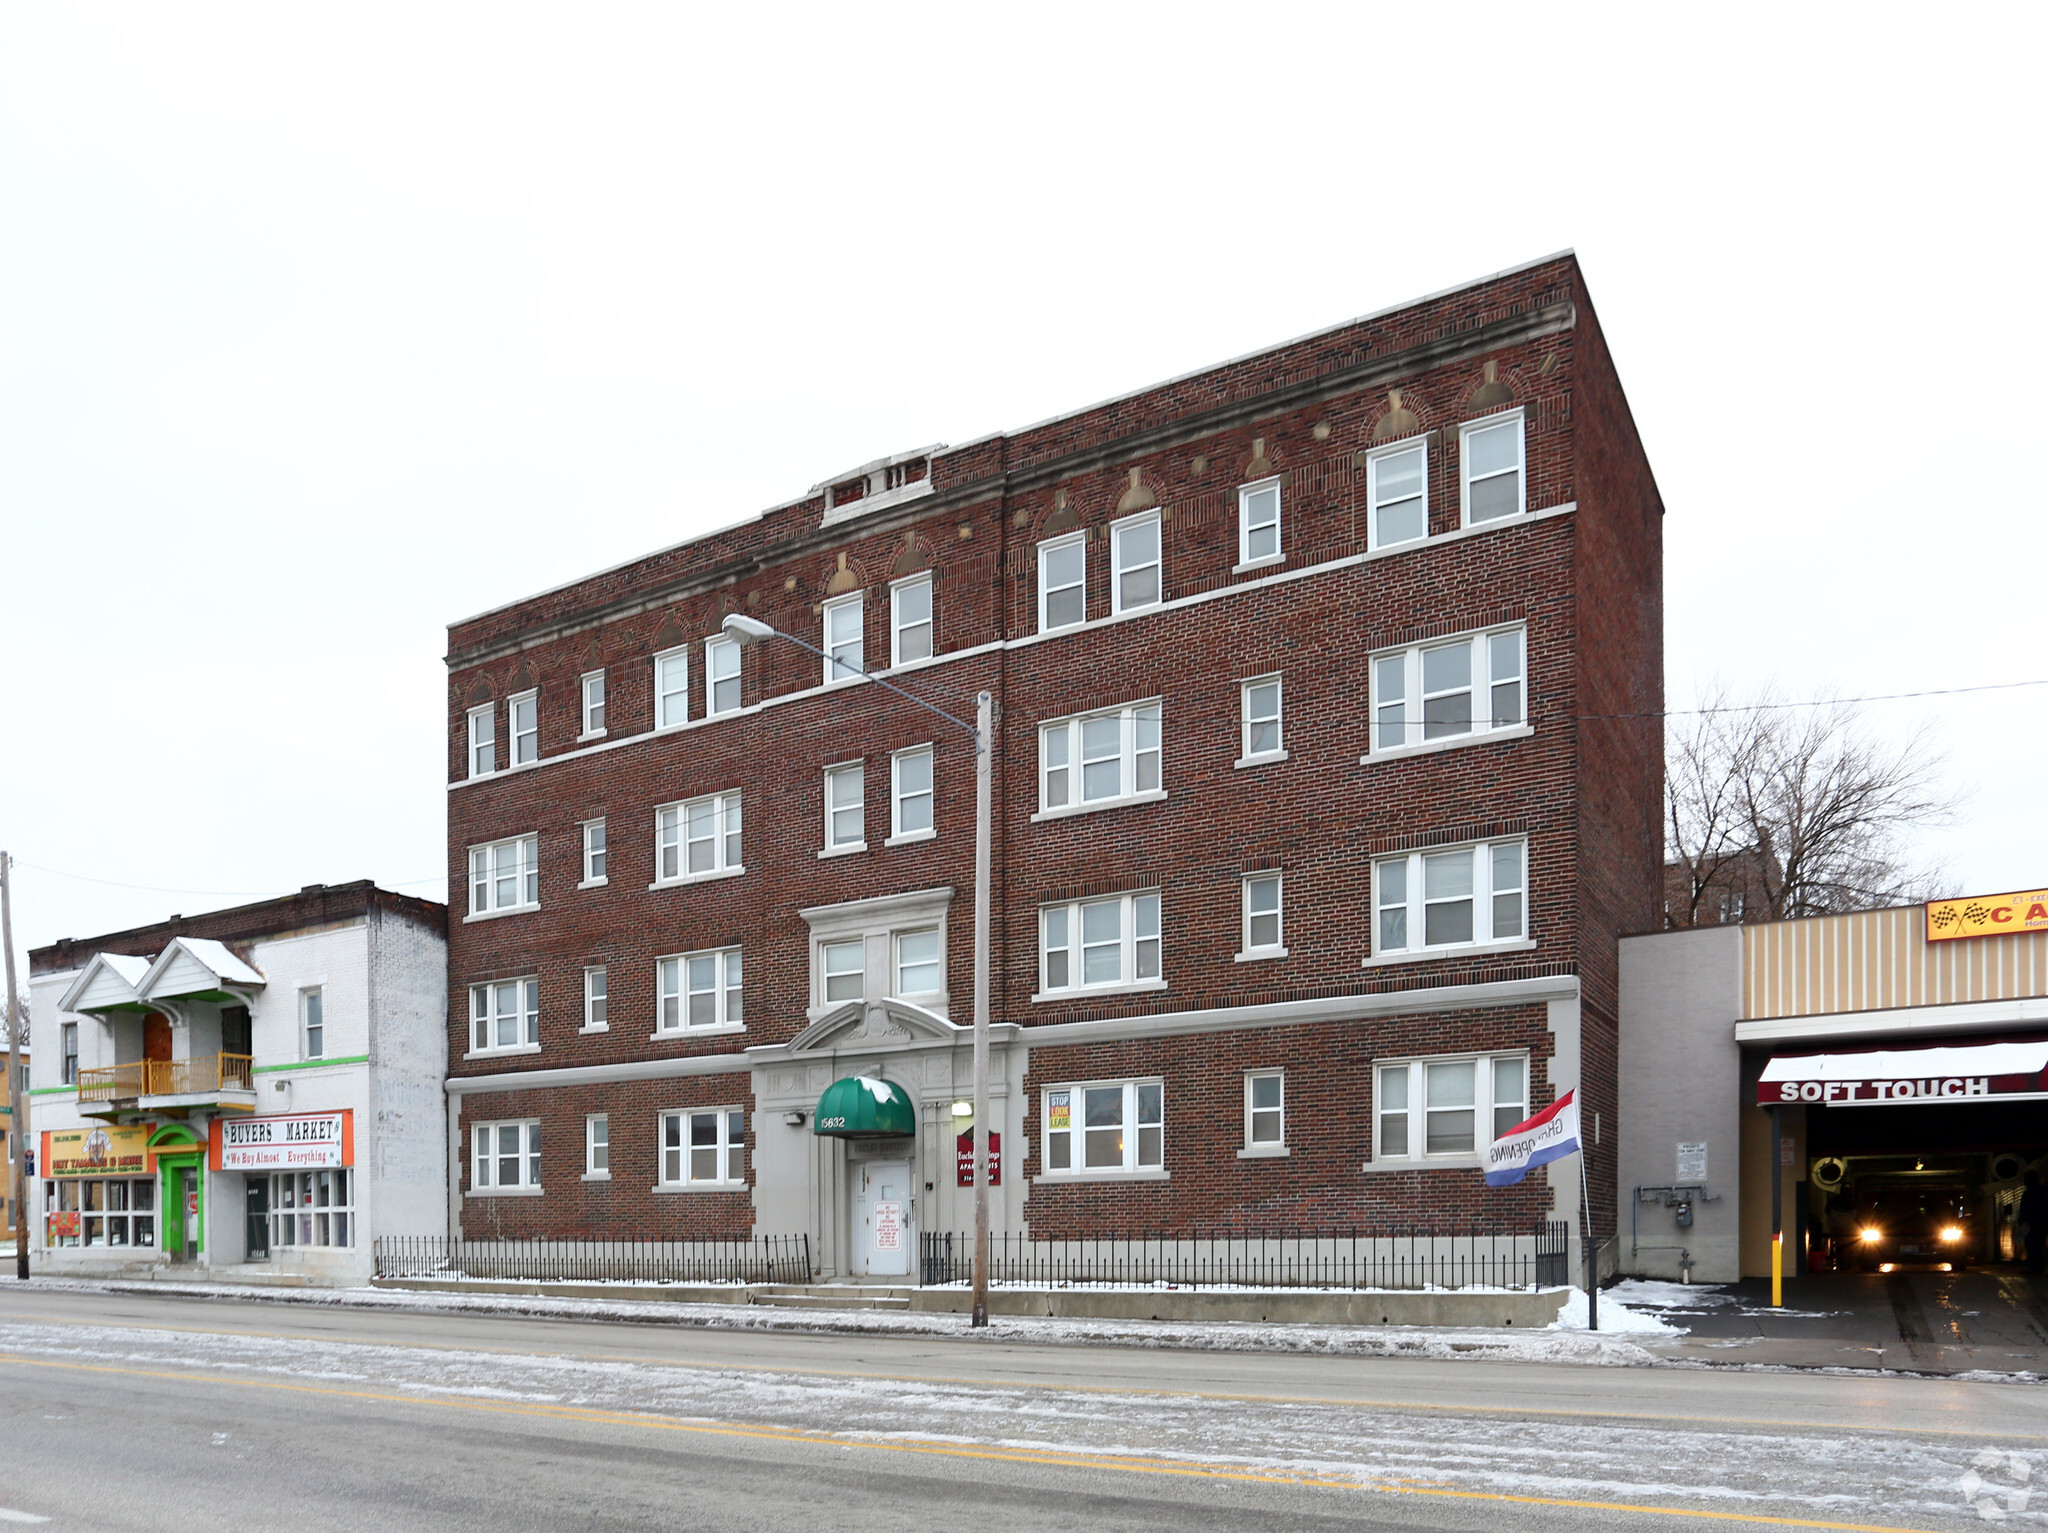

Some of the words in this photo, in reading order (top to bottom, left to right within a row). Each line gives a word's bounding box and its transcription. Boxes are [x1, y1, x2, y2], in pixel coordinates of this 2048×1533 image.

[1780, 1082, 1862, 1102] SOFT
[1872, 1077, 1989, 1099] TOUCH
[1051, 1096, 1068, 1106] STOP
[1051, 1106, 1069, 1117] LOOK
[821, 1117, 845, 1129] 15632
[1050, 1117, 1069, 1127] LEASE
[286, 1120, 333, 1141] MARKET
[230, 1152, 241, 1164] We
[242, 1151, 255, 1167] Buy
[256, 1150, 280, 1164] Almost
[287, 1148, 327, 1164] Everything
